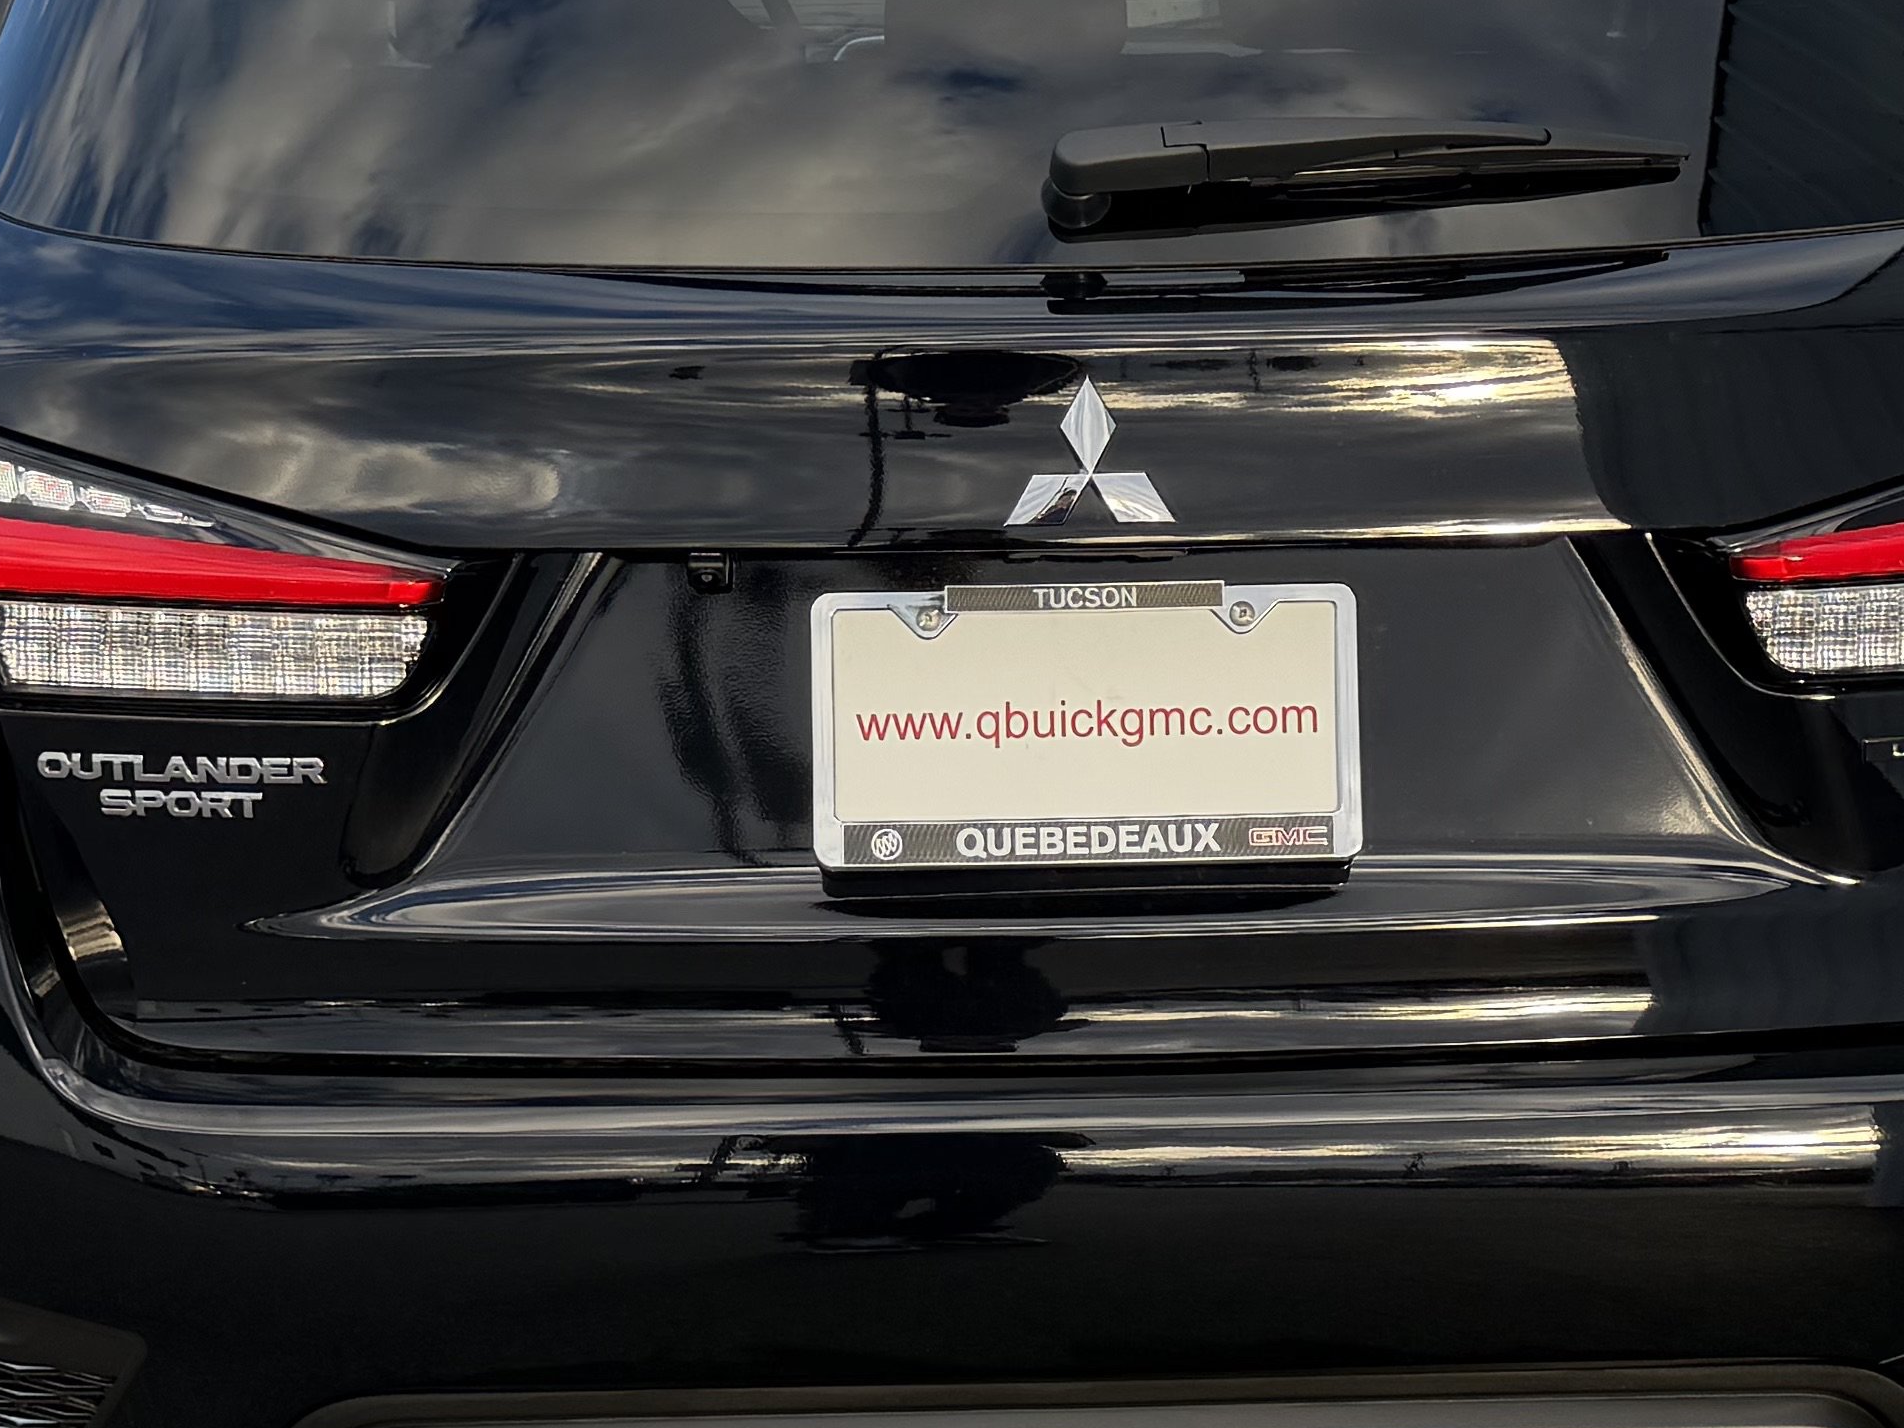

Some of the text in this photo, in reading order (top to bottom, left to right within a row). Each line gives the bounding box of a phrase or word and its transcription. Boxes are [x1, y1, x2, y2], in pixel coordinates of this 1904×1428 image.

[1032, 586, 1137, 610] TUCSON
[855, 699, 1319, 747] www.qbuickgmc.com
[36, 751, 328, 784] OUTLANDER
[99, 788, 263, 818] SPORT
[955, 822, 1329, 858] QUEBEDEAUX GMC
